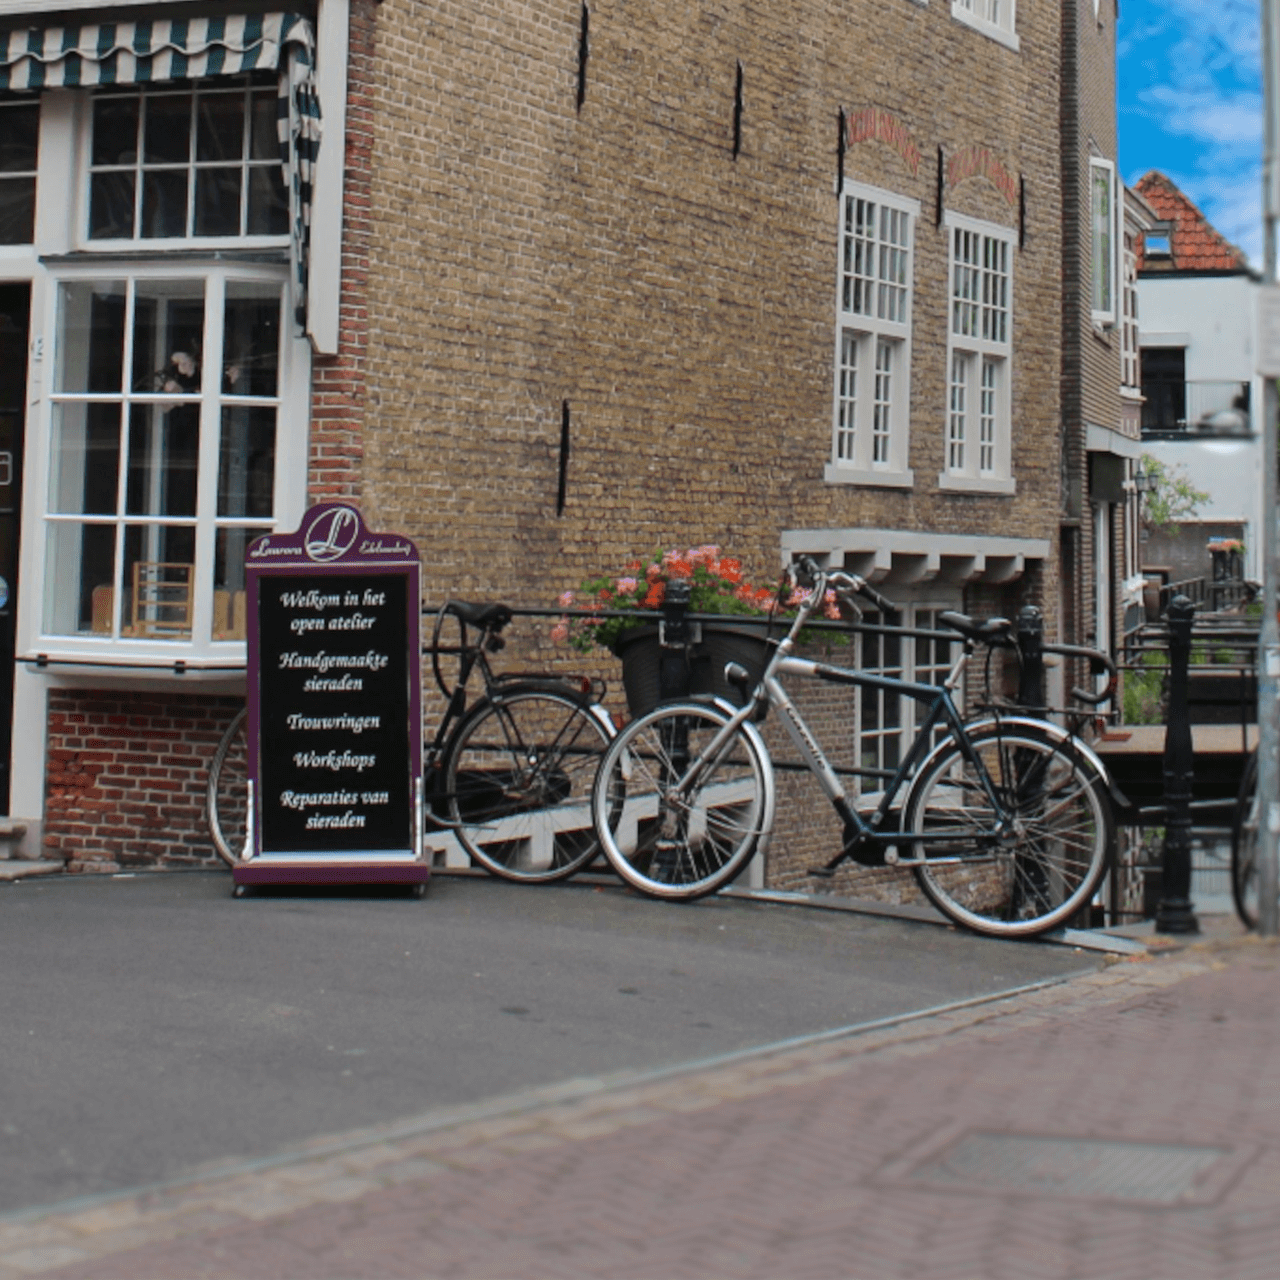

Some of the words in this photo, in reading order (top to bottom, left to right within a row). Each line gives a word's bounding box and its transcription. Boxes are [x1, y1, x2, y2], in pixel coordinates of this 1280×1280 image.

[279, 589, 340, 611] Welkom
[343, 590, 359, 606] in
[362, 588, 386, 606] het
[290, 618, 325, 636] open
[328, 612, 376, 631] atelier
[278, 650, 389, 673] Handgemaakte
[303, 673, 363, 692] sieraden
[286, 712, 381, 734] Trouwringen
[293, 749, 376, 772] Workshops
[279, 788, 358, 811] Reparaties
[360, 791, 389, 805] van
[305, 810, 366, 829] sieraden
